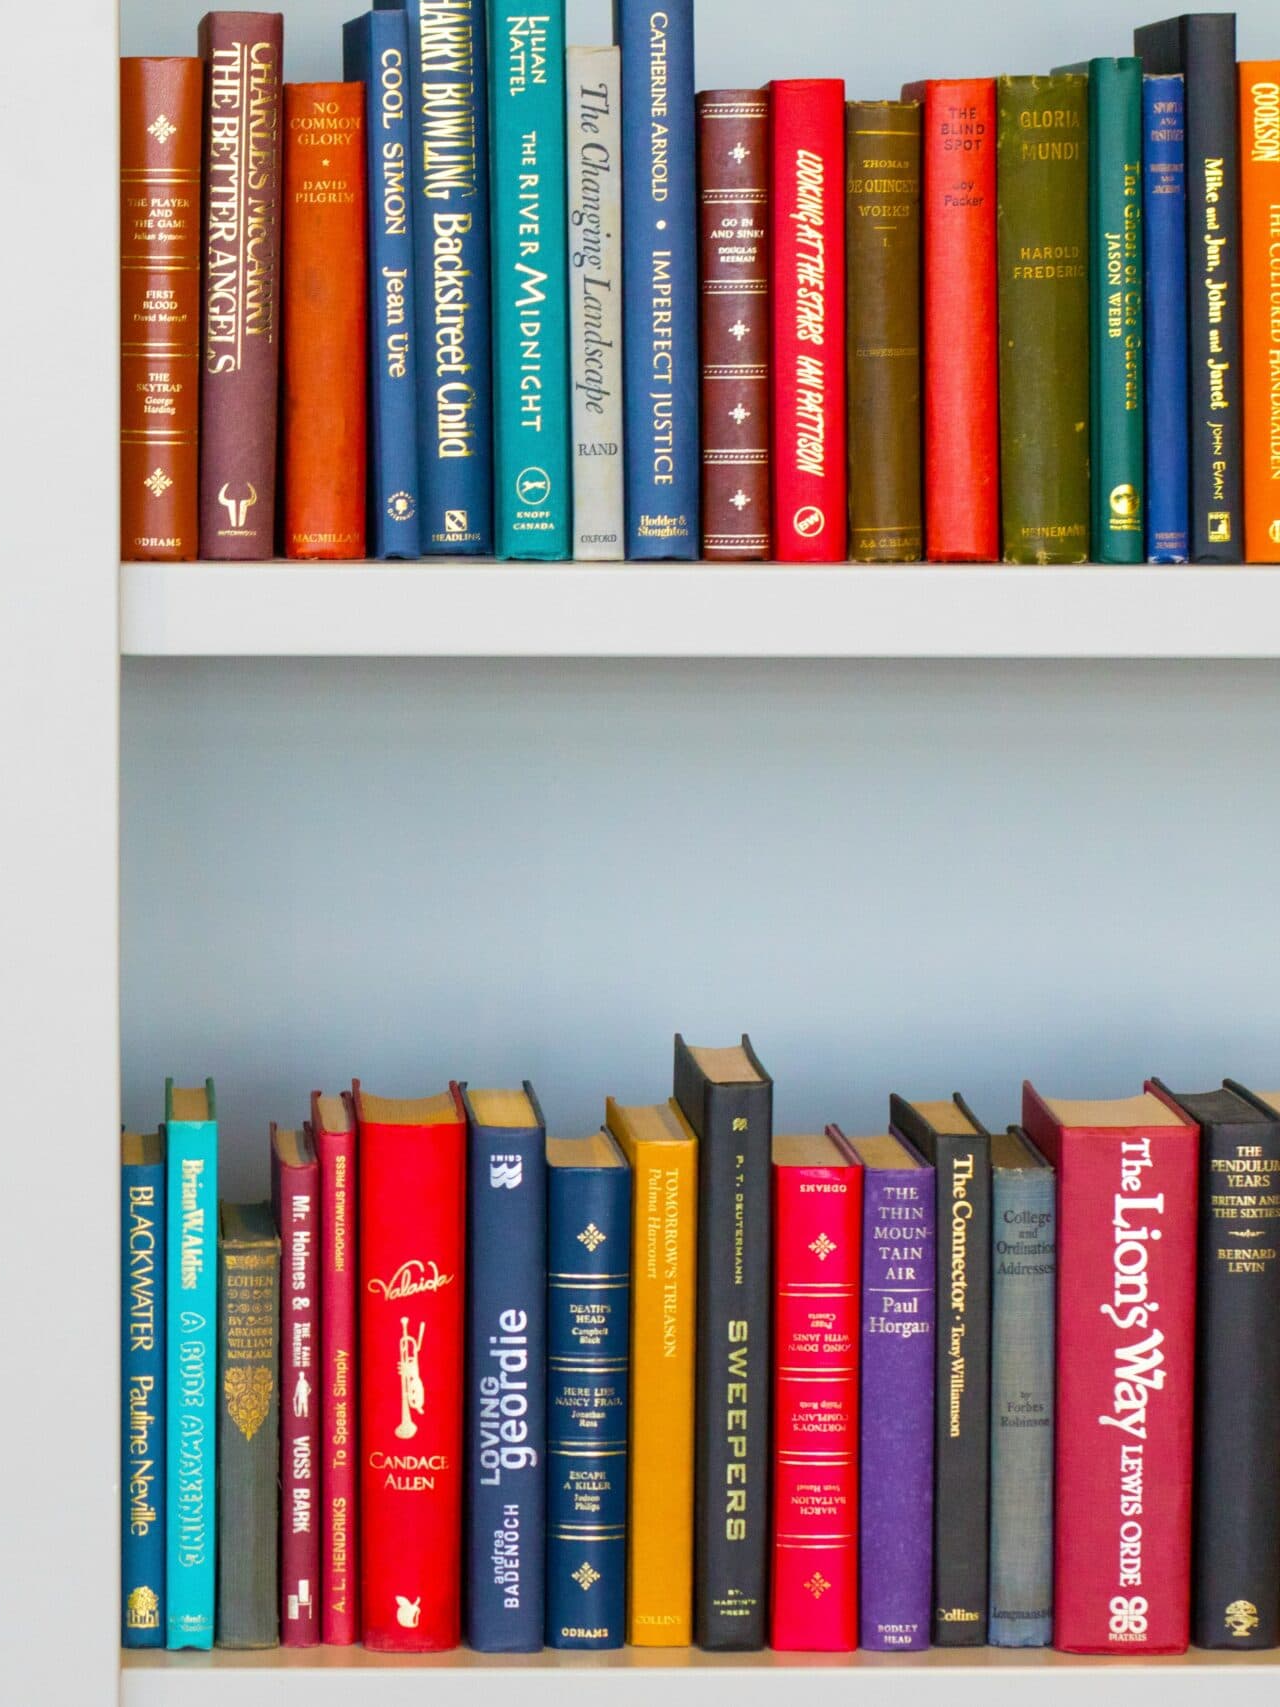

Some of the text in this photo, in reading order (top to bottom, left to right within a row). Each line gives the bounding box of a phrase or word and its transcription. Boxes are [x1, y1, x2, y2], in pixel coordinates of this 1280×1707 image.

[508, 15, 530, 97] NATTEL
[531, 15, 552, 85] LILIAN
[289, 116, 362, 130] COMMON
[296, 132, 354, 146] GLORY
[312, 102, 340, 115] NO
[379, 47, 408, 236] COOL SIMON
[649, 10, 670, 203] CATHERINE ARNOLD
[939, 122, 986, 137] BLIND
[947, 106, 978, 121] THE
[571, 82, 612, 416] The Changing Landscape
[857, 204, 911, 218] WORKS
[513, 130, 549, 432] THE RIVER MIDNIGHT
[1019, 246, 1080, 260] HAROLD
[1104, 231, 1124, 339] JASON WEBB
[433, 211, 479, 459] Backstreet Child
[648, 249, 673, 486] IMPERFECT JUSTICE
[577, 442, 619, 457] RAND
[795, 353, 826, 477] IAN PATTISON
[580, 533, 618, 543] OXFORD
[799, 1184, 848, 1194] ODHAMS
[1226, 1174, 1271, 1188] YEARS
[1235, 1145, 1264, 1158] THE
[334, 1155, 346, 1273] HIPPOPOTAMUS PRESS
[645, 1167, 663, 1279] Palma Harcourt
[733, 1154, 746, 1286] P. T. DEUTERMANN
[878, 1206, 925, 1221] THIN
[882, 1187, 920, 1202] THE
[1003, 1208, 1053, 1227] College
[291, 1194, 311, 1311] Mr. Holmes &
[662, 1167, 680, 1359] TOMORROW'S TREASON
[878, 1246, 924, 1261] TAIN
[1098, 1137, 1167, 1440] The Lion's Way
[575, 1314, 607, 1325] HEAD
[868, 1315, 931, 1340] Horgan
[881, 1296, 919, 1314] Paul
[946, 1154, 974, 1438] The Connector Tony Williamson
[128, 1185, 156, 1537] BLACKWATER Pauline Neville
[489, 1308, 537, 1470] geordie
[329, 1348, 350, 1470] To Speak Simply
[479, 1375, 502, 1487] LOVING
[723, 1318, 749, 1542] SWEEPERS
[291, 1435, 311, 1535] VOSS BARK
[383, 1472, 436, 1491] ALLEN
[799, 1506, 838, 1516] MARCH
[1118, 1443, 1146, 1588] LEWIS ORDE
[332, 1496, 348, 1613] A. L. HENDRIKS
[492, 1530, 510, 1586] andrea
[503, 1503, 520, 1609] BADENOCH
[560, 1626, 610, 1640] ODHAMS
